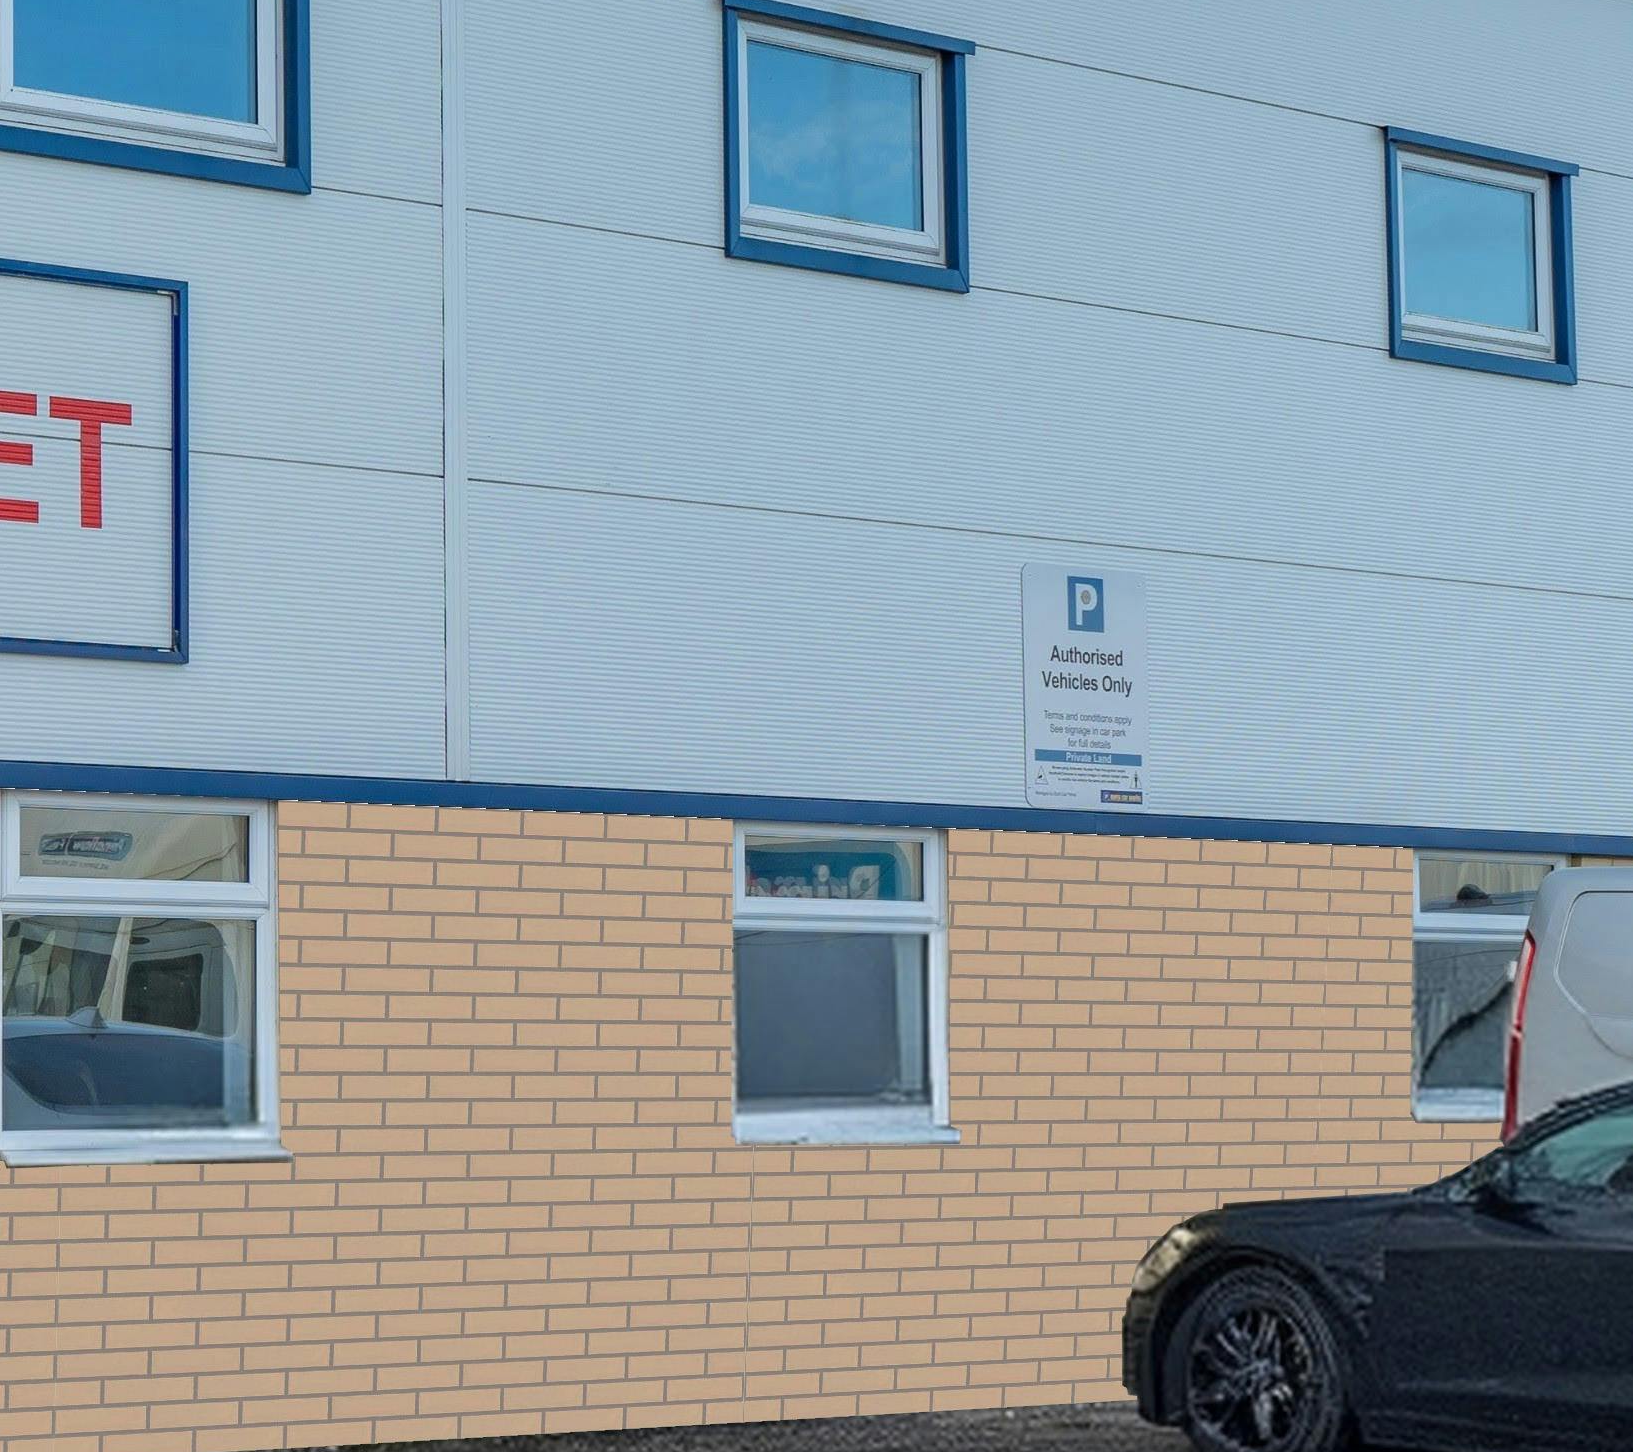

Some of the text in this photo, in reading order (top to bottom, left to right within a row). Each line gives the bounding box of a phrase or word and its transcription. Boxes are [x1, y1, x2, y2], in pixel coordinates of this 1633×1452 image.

[1050, 644, 1123, 666] Authorised
[1041, 670, 1132, 698] Vehicles Only
[1044, 709, 1133, 727] Terms and conditions apply
[1049, 723, 1127, 738] See signage in car park
[1067, 737, 1112, 749] for full details
[1065, 751, 1112, 764] Private Land
